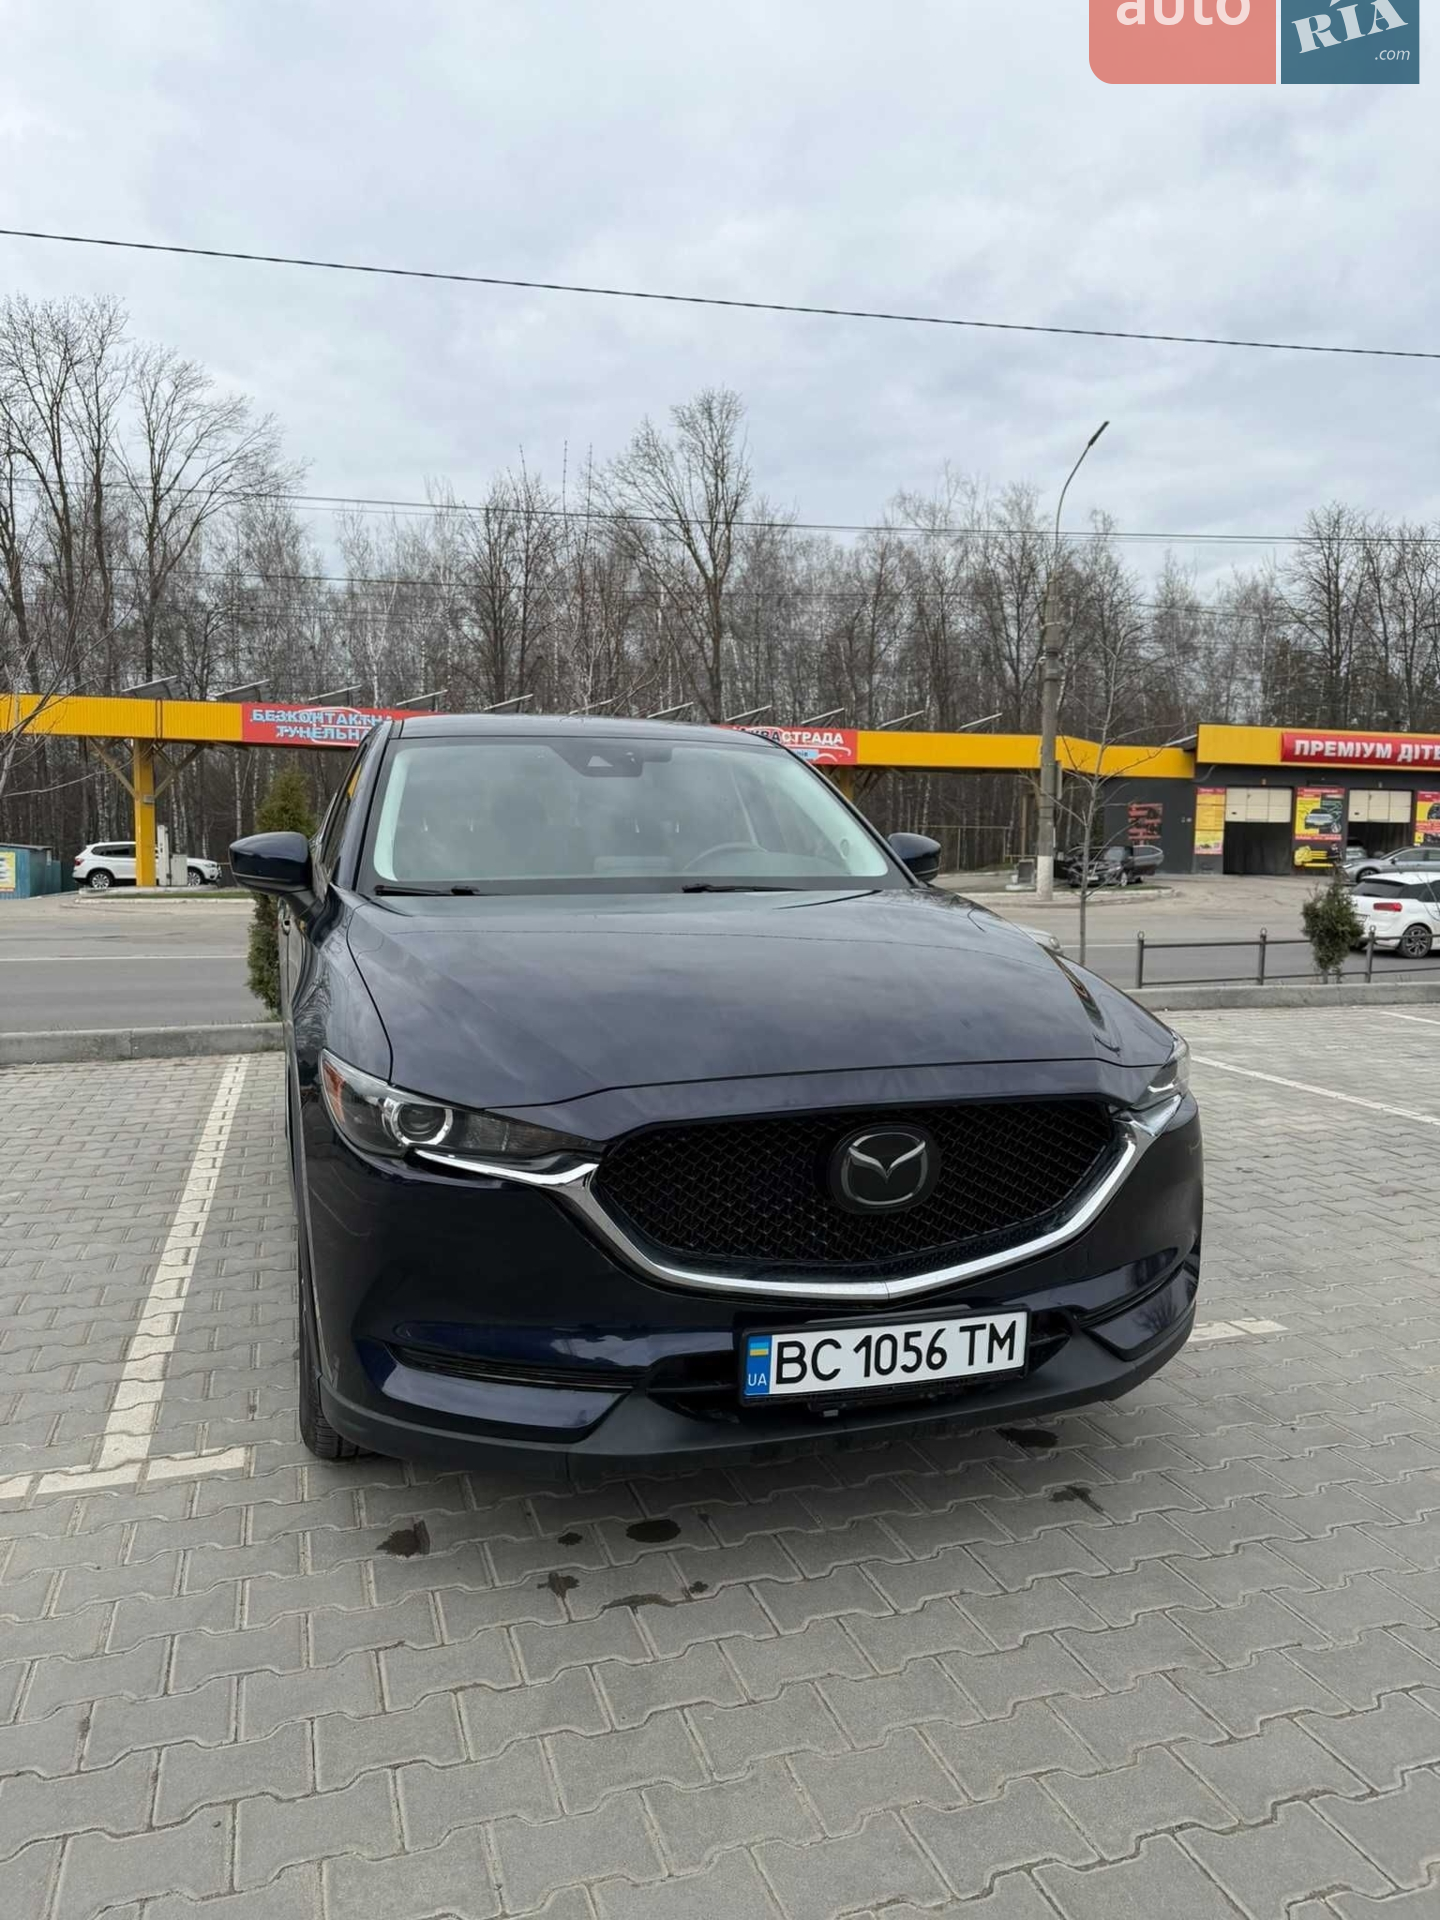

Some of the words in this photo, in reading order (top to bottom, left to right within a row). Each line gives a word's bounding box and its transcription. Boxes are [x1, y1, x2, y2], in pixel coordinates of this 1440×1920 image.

[1294, 739, 1392, 759] ПРЕМІУМ
[776, 1338, 842, 1384] BC
[853, 1328, 947, 1378] 1056
[959, 1320, 1016, 1366] TM
[748, 1373, 767, 1386] UA
